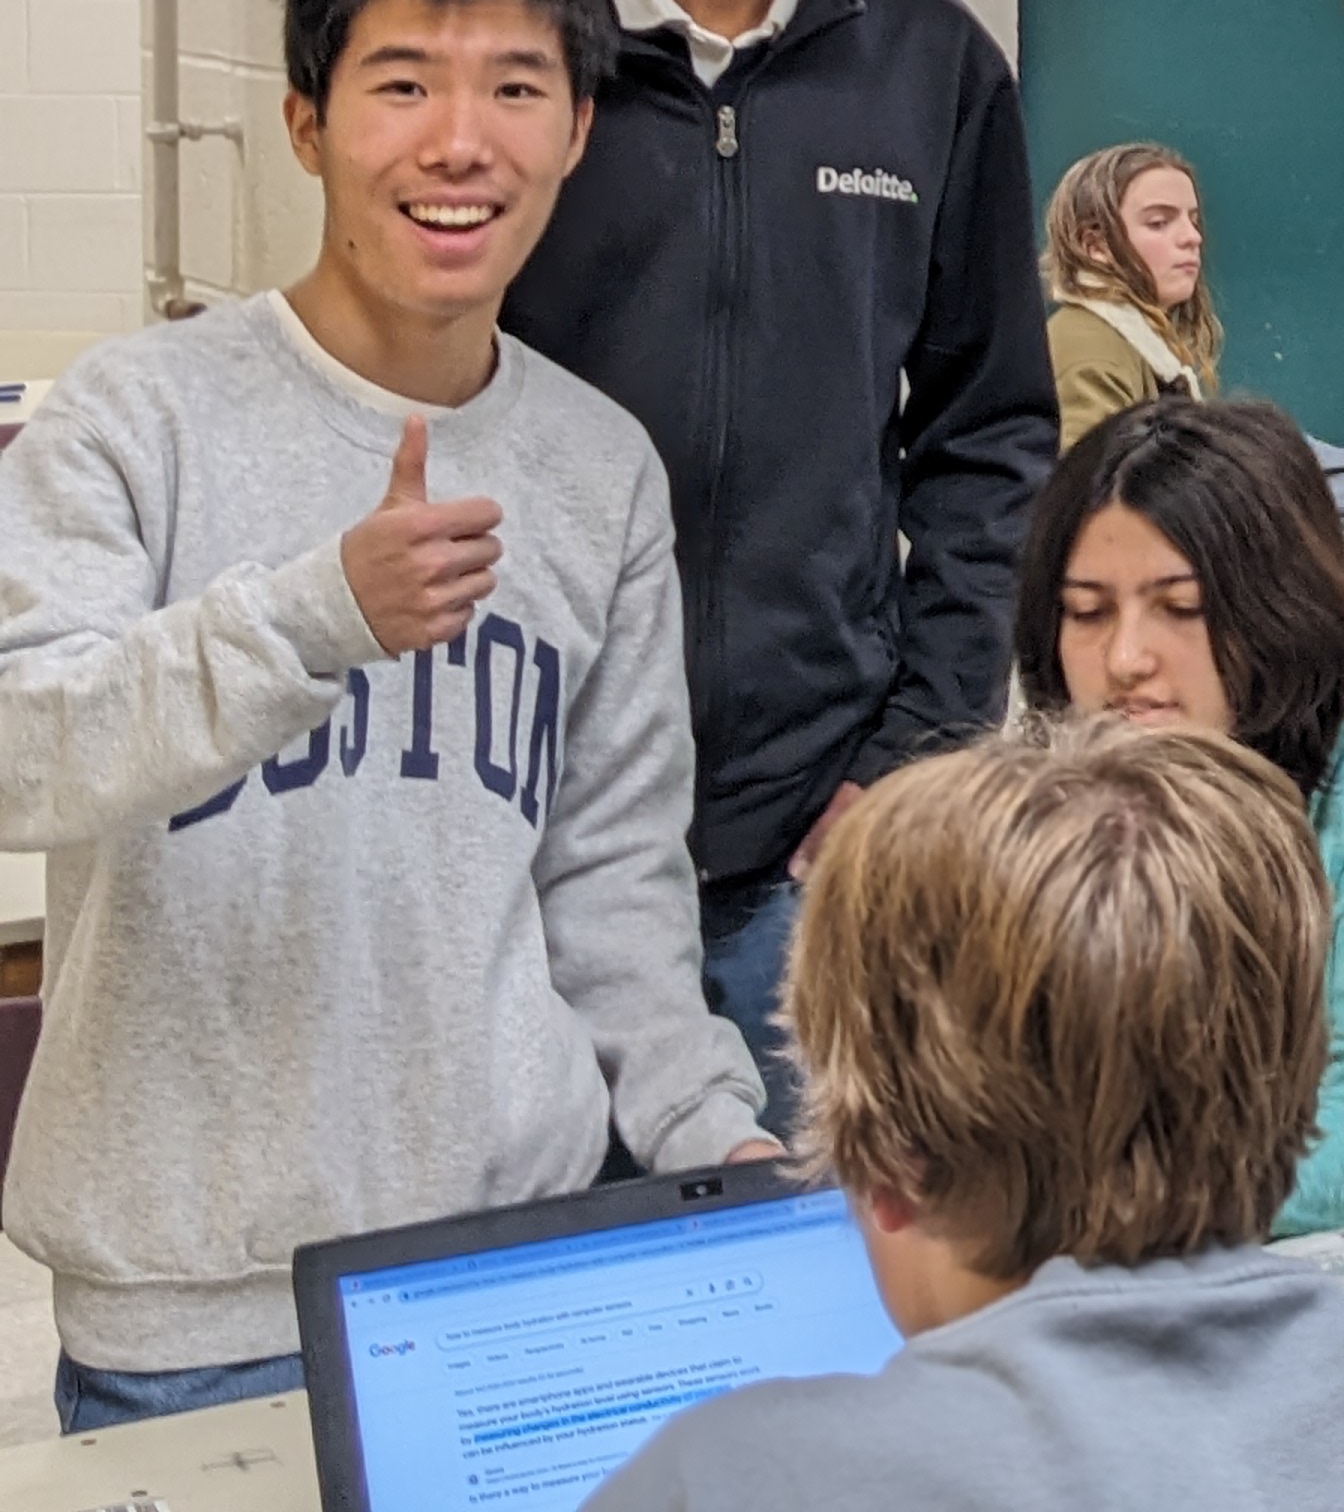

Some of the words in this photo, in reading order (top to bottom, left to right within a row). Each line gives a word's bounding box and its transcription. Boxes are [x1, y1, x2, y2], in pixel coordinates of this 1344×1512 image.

[369, 1339, 416, 1358] Google
[518, 1388, 571, 1407] smartphone
[573, 1386, 594, 1396] apps
[596, 1380, 613, 1390] and
[614, 1373, 653, 1387] wearable
[655, 1366, 688, 1379] devices
[690, 1362, 706, 1372] that
[458, 1418, 496, 1430] measure
[499, 1414, 518, 1424] your
[551, 1398, 593, 1414] hydration
[616, 1389, 639, 1402] using
[678, 1377, 703, 1388] These
[474, 1426, 521, 1443] measuring
[522, 1419, 559, 1434] changes
[628, 1396, 681, 1414] conductivity
[494, 1436, 541, 1451] influenced
[556, 1432, 574, 1441] your
[576, 1421, 618, 1437] hydration
[542, 1477, 579, 1488] measure
